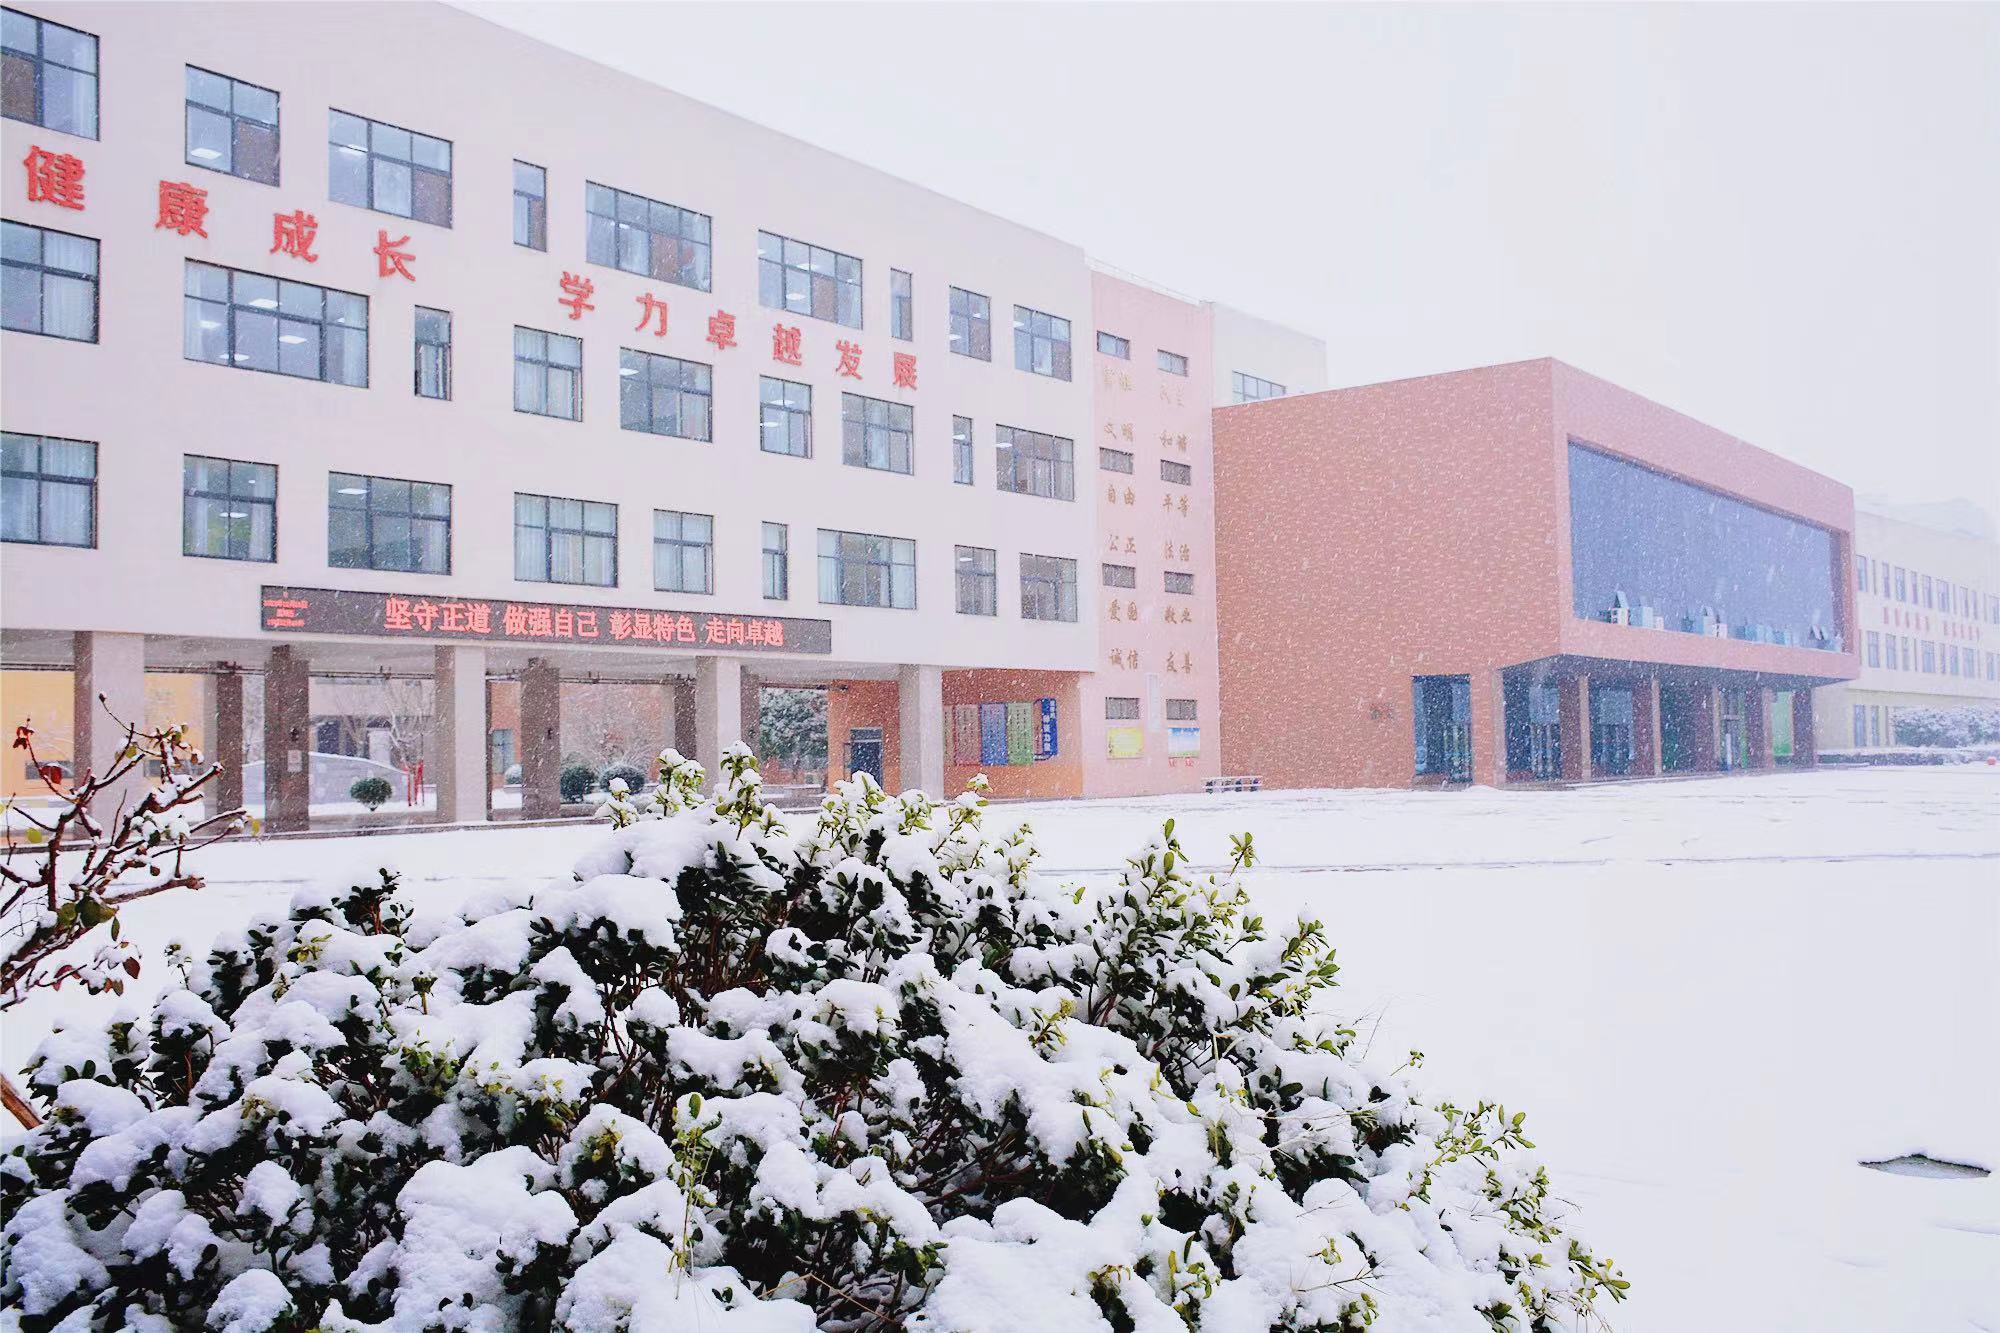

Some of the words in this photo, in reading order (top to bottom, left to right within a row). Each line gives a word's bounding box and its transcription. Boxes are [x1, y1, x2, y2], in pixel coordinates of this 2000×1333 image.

[23, 145, 416, 282] 健康成长
[558, 271, 919, 391] 学力卓越发展
[384, 597, 491, 633] 坚守正道
[503, 604, 600, 638] 做强自己
[608, 611, 697, 642] 彰显特色
[705, 617, 784, 647] 走向卓越
